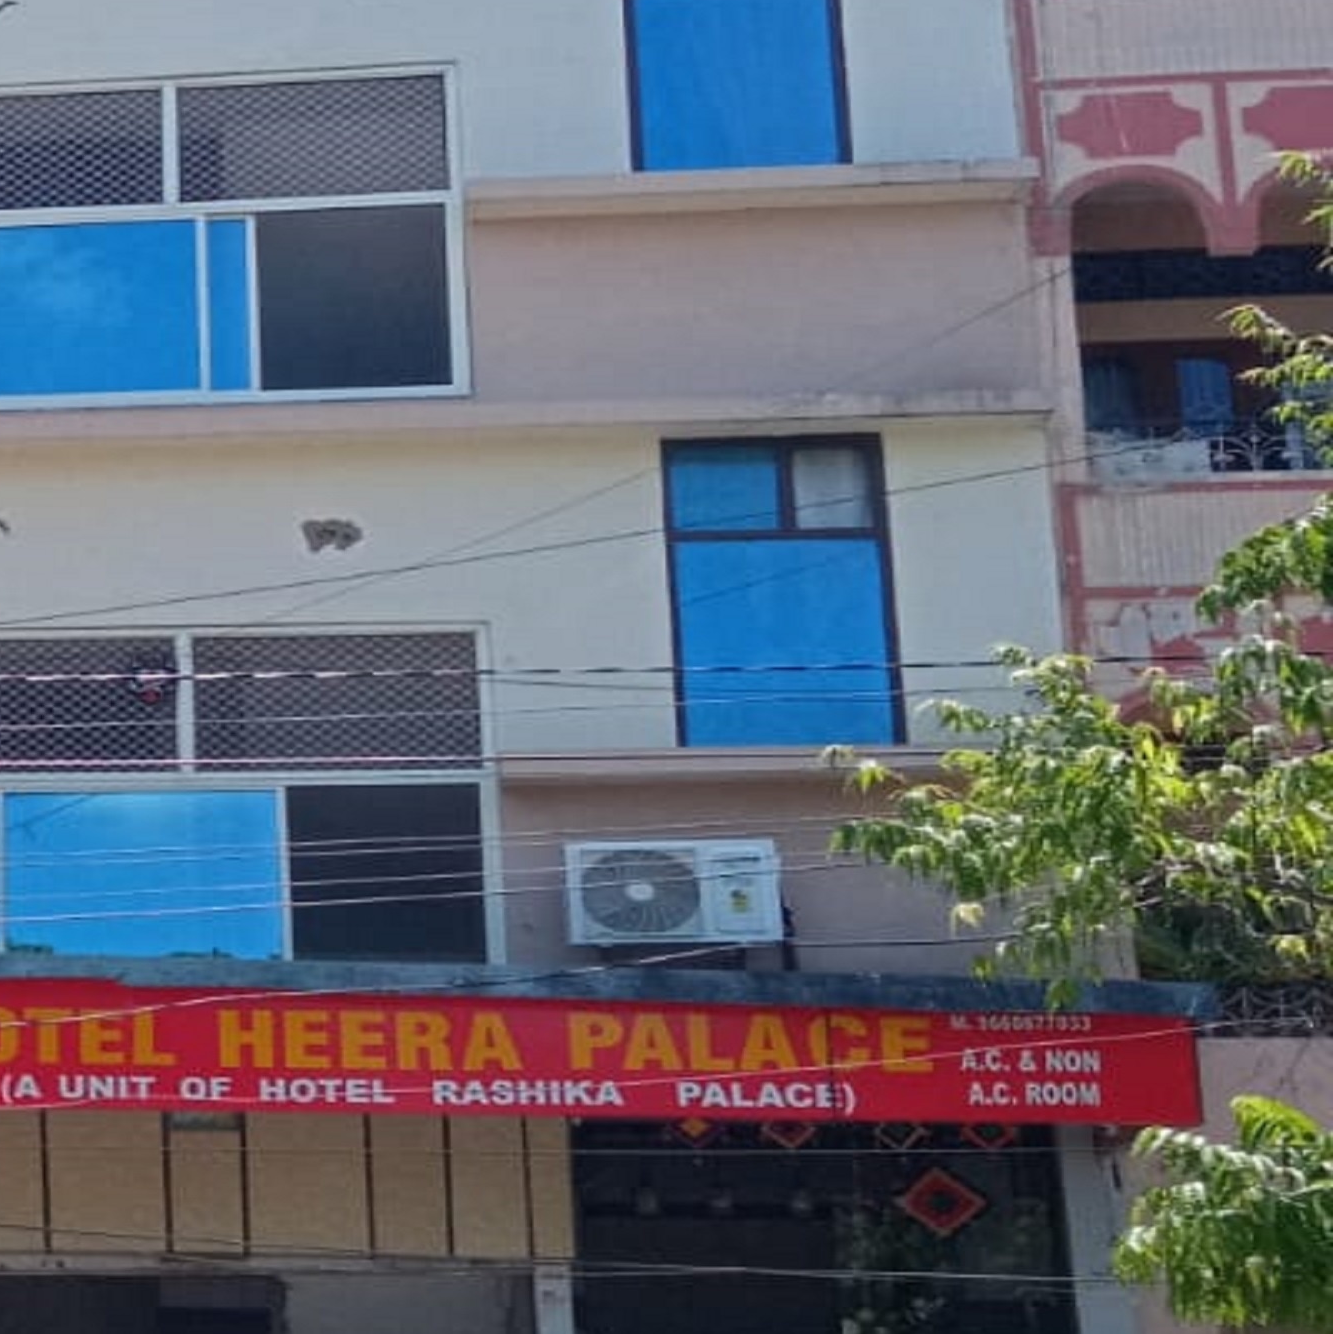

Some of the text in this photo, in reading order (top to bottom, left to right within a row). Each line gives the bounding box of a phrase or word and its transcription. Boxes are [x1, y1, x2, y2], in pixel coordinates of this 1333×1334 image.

[217, 1008, 522, 1072] HEERA
[569, 1012, 934, 1073] PALACE
[961, 1048, 1101, 1073] A.C. & NON
[1, 1074, 857, 1115] (A UNIT OF HOTEL RASHIKA PALACE)
[968, 1081, 1102, 1107] A.C. ROOM
